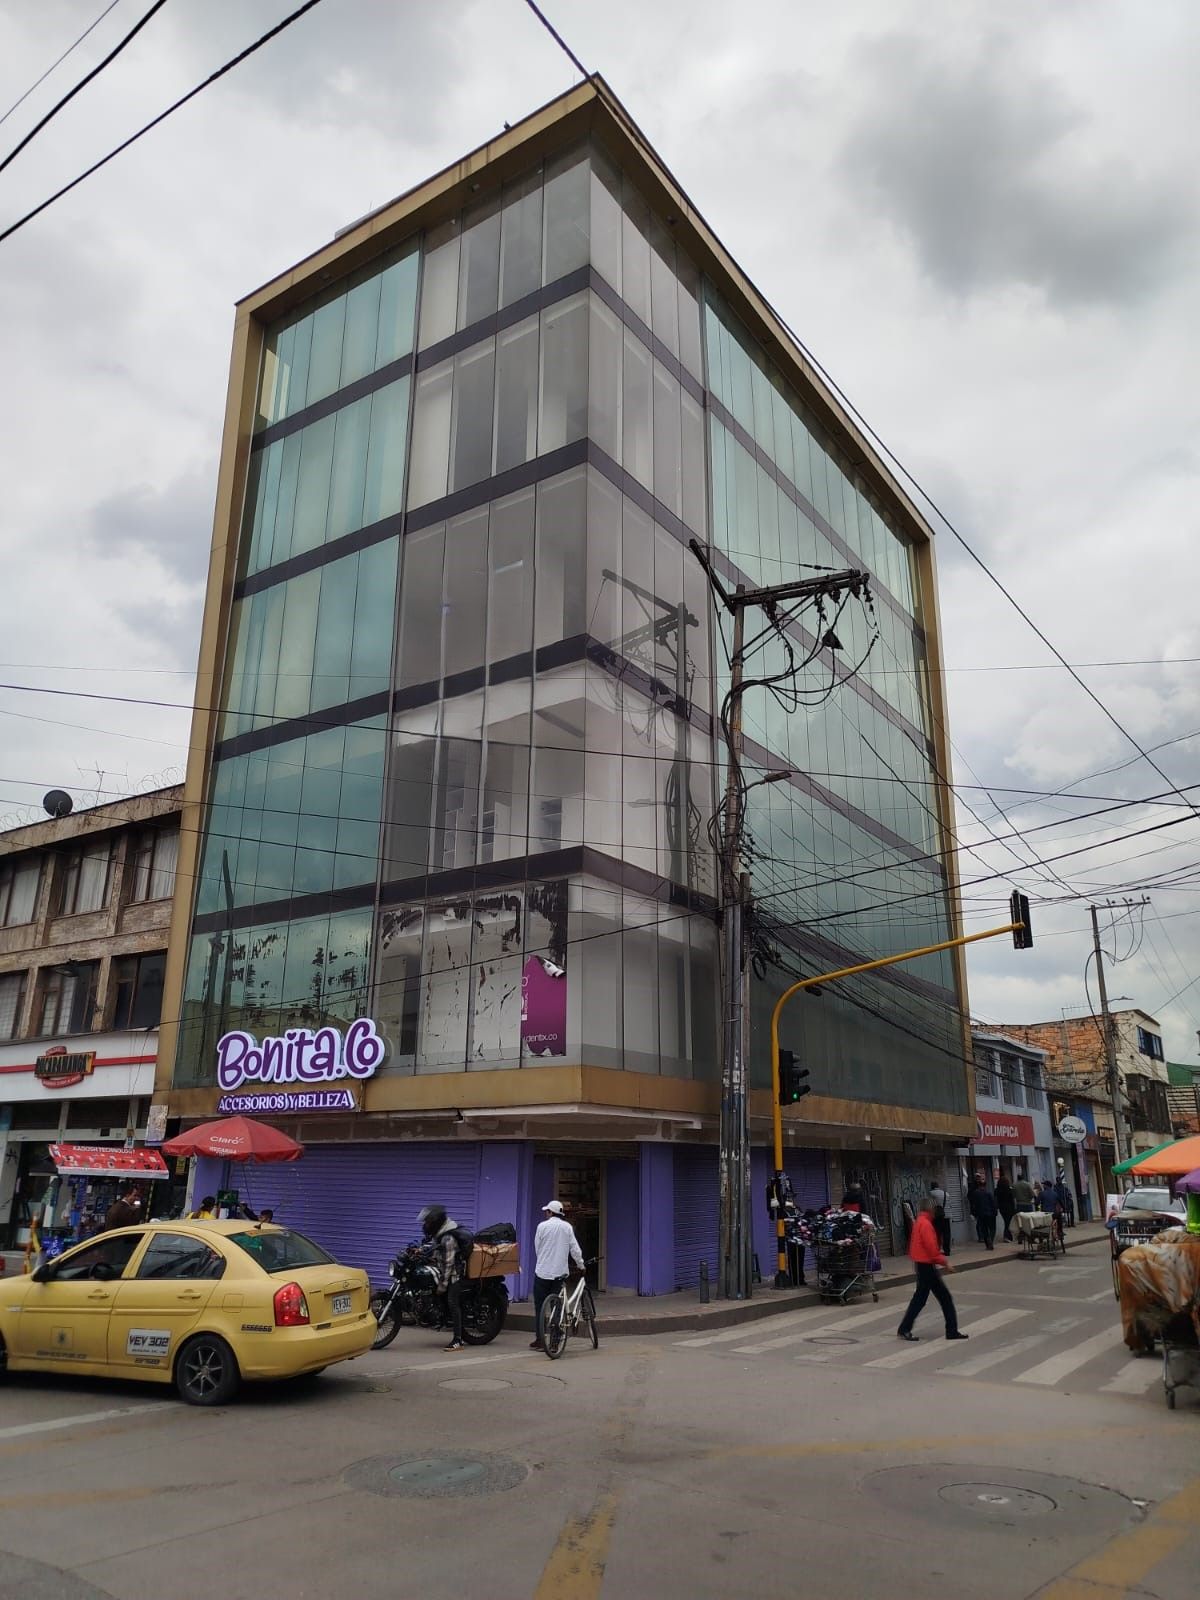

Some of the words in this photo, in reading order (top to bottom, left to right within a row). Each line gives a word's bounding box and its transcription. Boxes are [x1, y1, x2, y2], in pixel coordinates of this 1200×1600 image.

[218, 1020, 380, 1088] Bonita.Co
[219, 1094, 285, 1111] ACCESORIOS
[289, 1094, 297, 1108] Y
[298, 1091, 350, 1108] BELLEZA
[210, 1136, 240, 1145] Claro
[148, 1336, 170, 1347] 302
